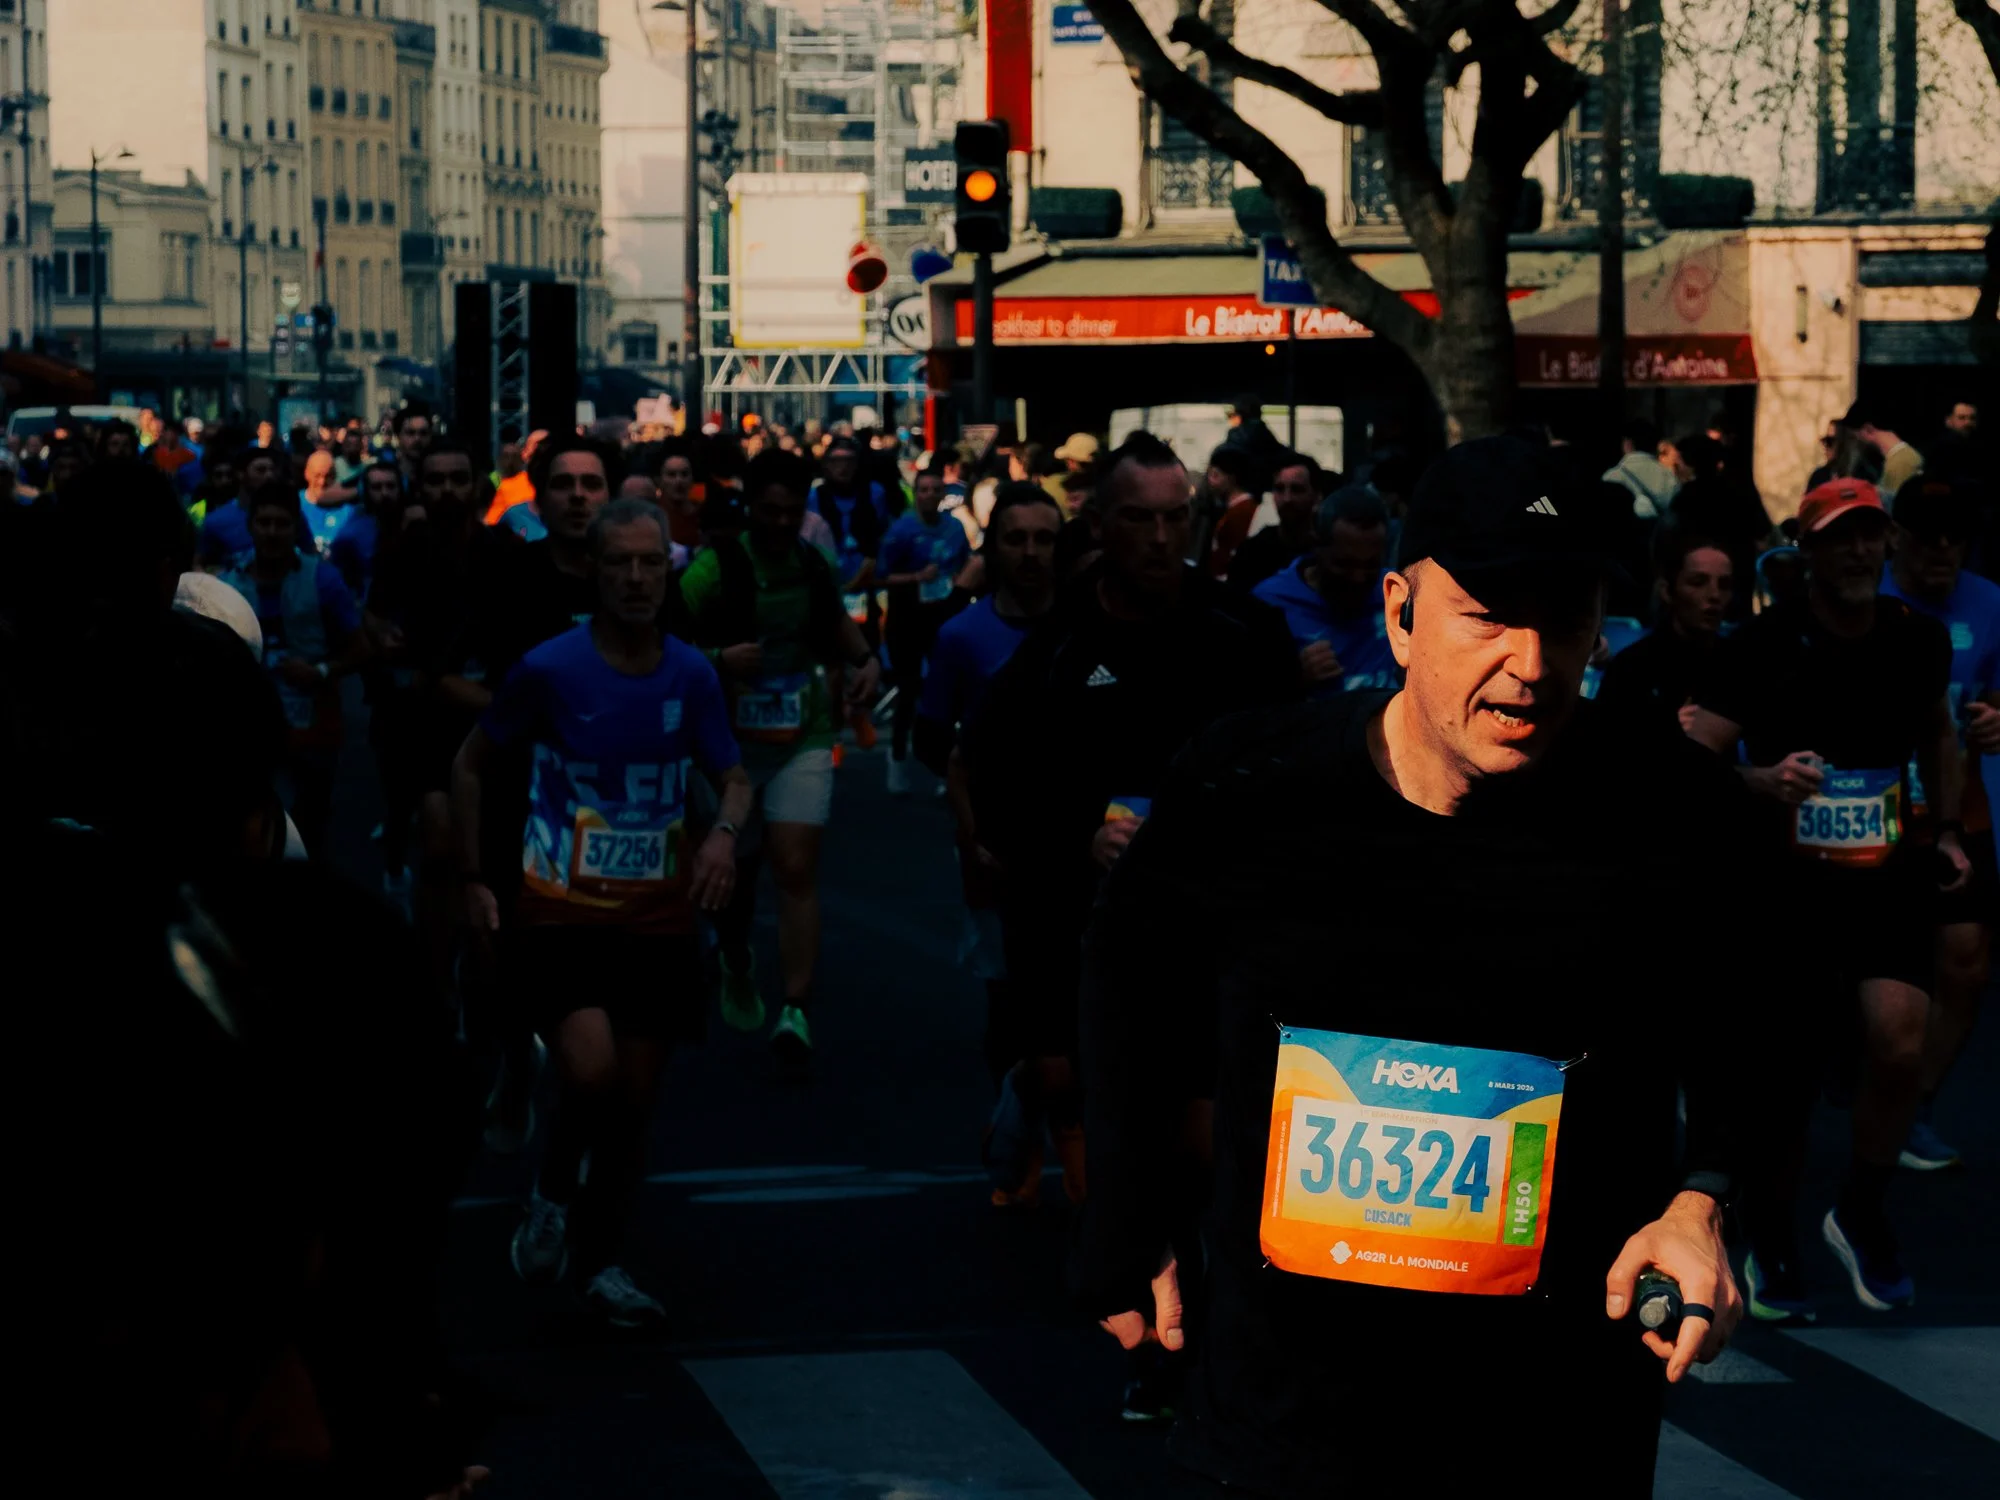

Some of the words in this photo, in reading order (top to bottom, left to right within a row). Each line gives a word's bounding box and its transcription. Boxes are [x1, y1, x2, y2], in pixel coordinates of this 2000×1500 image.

[905, 160, 958, 191] HOTE
[1186, 307, 1210, 336] Le
[1214, 306, 1282, 336] Bistrot
[1540, 349, 1562, 380] Le
[1633, 348, 1729, 380] d'Antoine
[1800, 804, 1882, 840] 38534
[586, 832, 660, 869] 37256
[1371, 1059, 1459, 1094] HOKA
[1494, 1082, 1515, 1090] MARS
[1516, 1083, 1535, 1092] 2026
[1300, 1113, 1492, 1213] 36324
[1364, 1208, 1412, 1228] CUSACK
[1512, 1181, 1533, 1235] 1H50
[1355, 1250, 1387, 1265] AG2R
[1389, 1253, 1404, 1267] LA
[1407, 1255, 1469, 1273] MONDIALE
